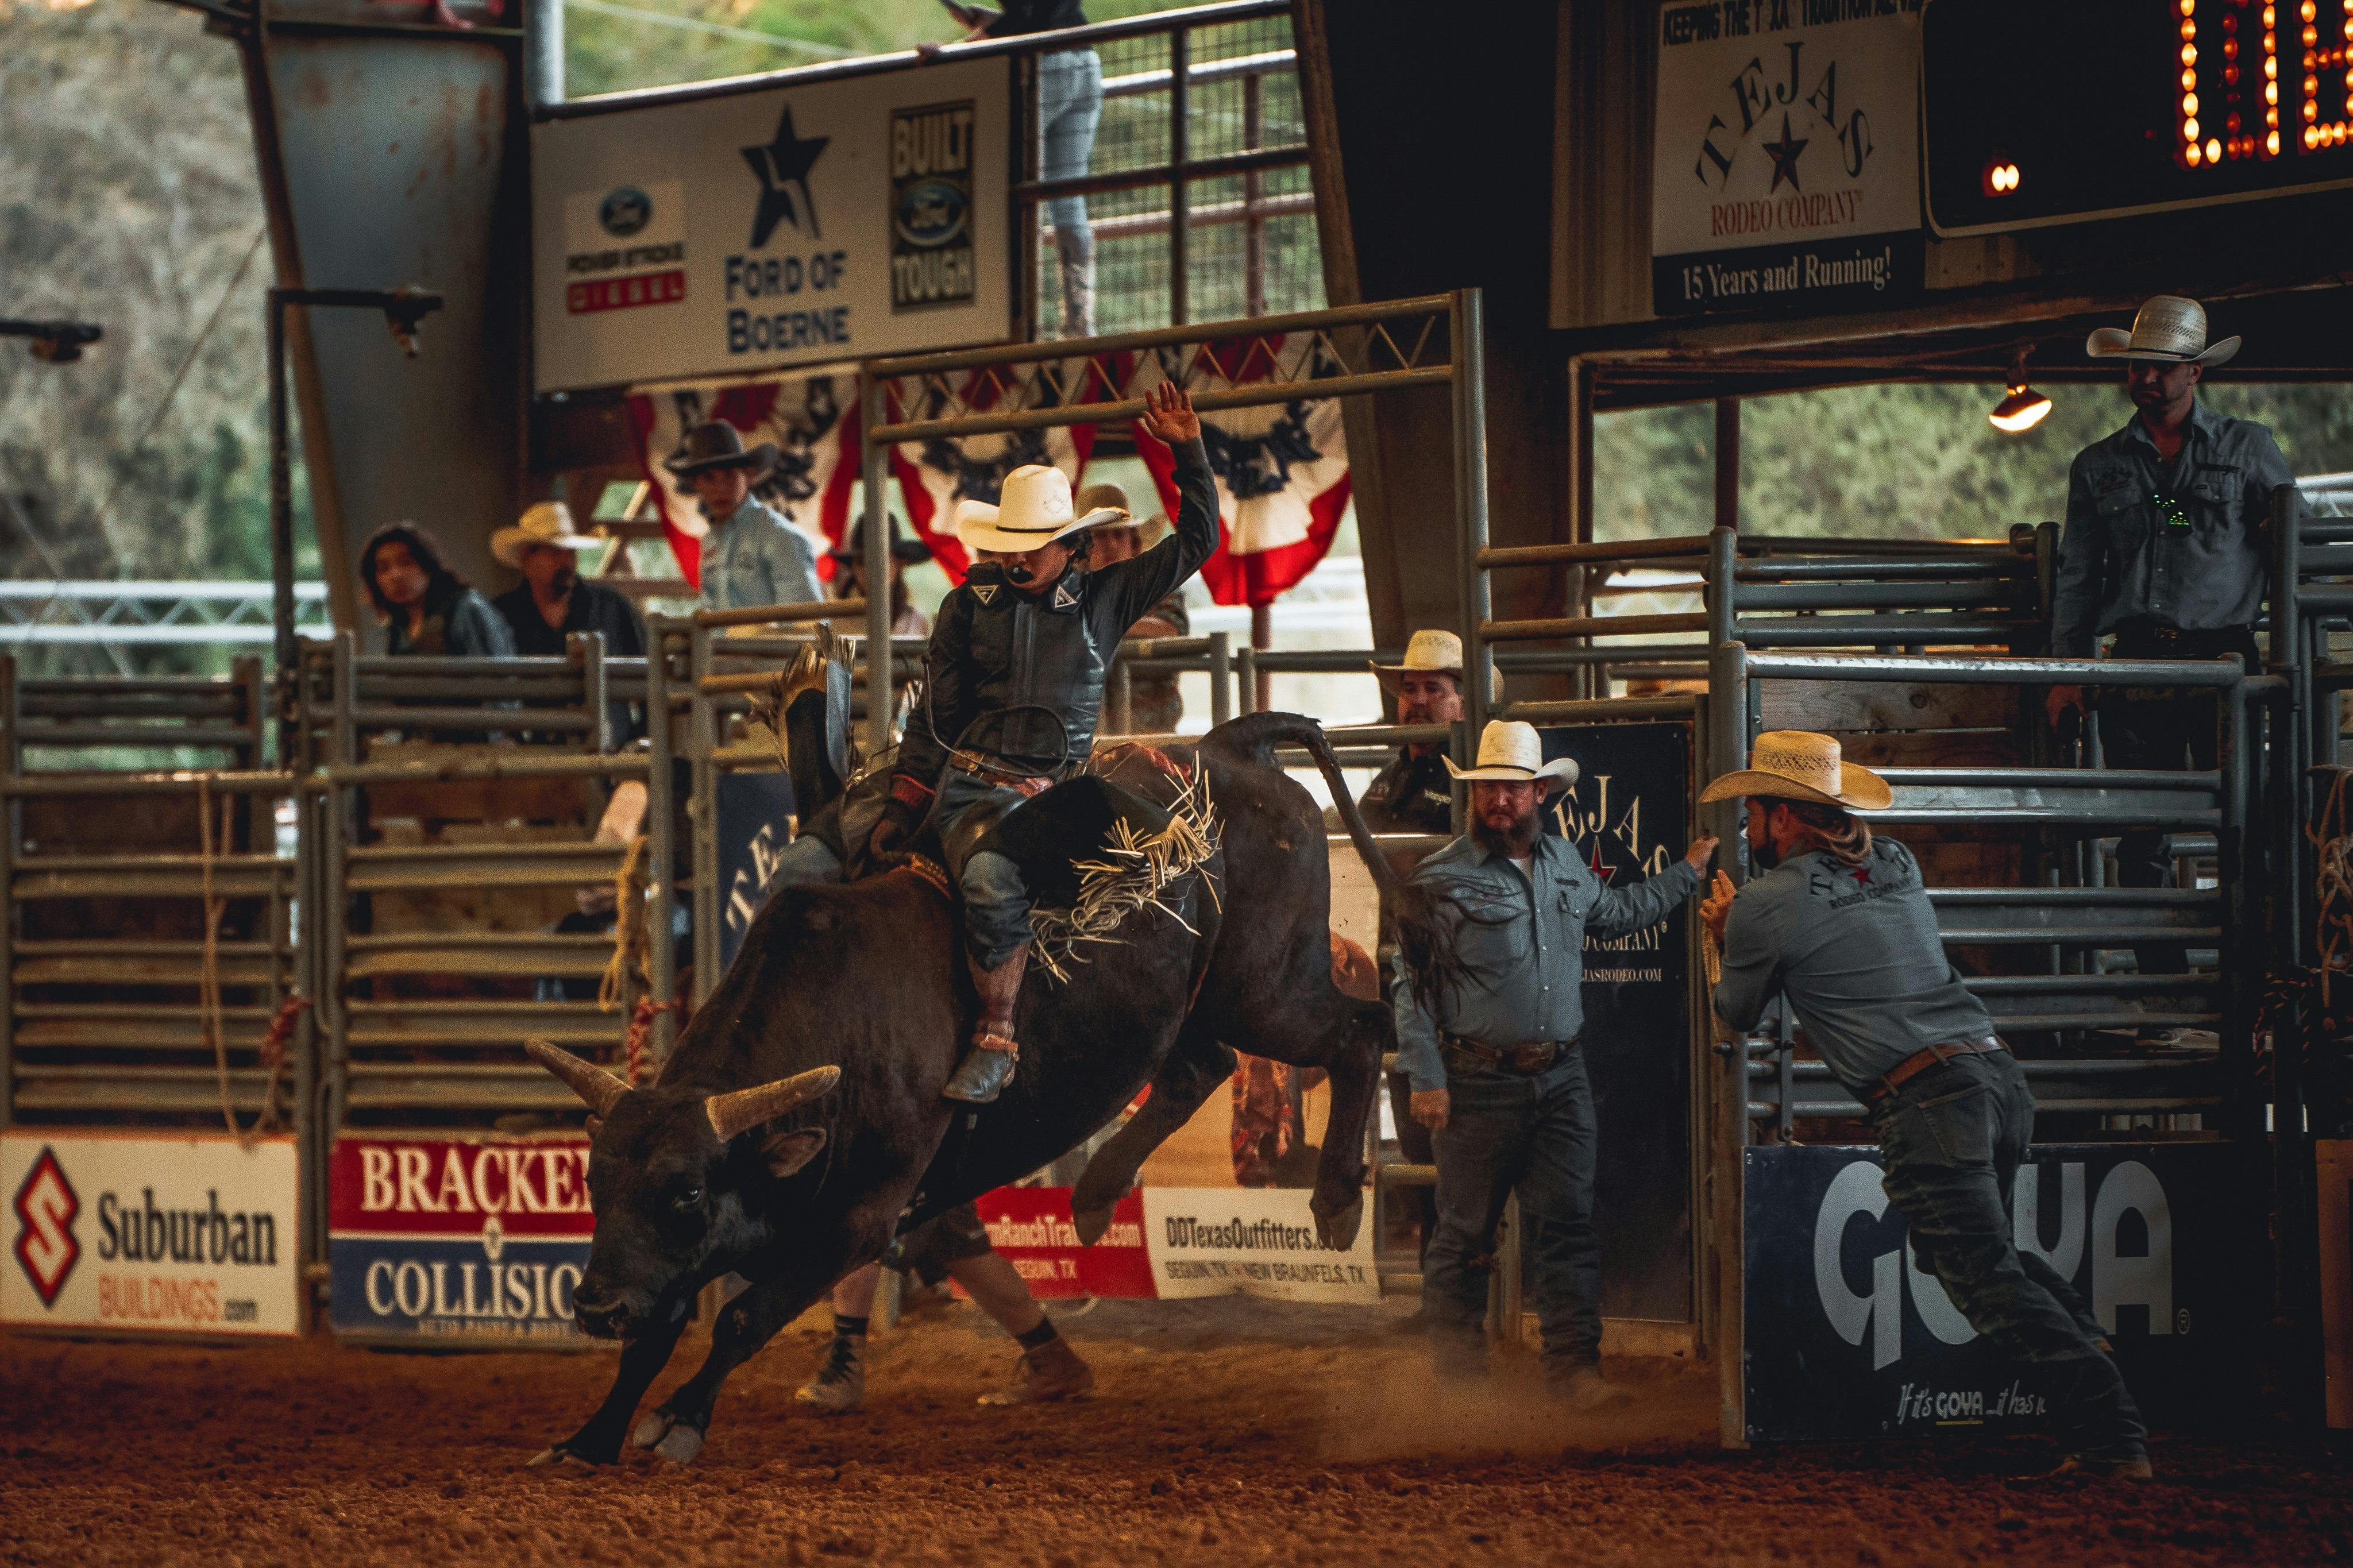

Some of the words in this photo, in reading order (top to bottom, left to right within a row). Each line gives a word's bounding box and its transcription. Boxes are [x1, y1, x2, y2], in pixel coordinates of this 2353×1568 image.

[1724, 0, 1750, 37] THE
[1695, 41, 1874, 191] TEJAS
[893, 109, 973, 179] BUILT
[1712, 200, 1773, 237] RODEO
[1777, 190, 1858, 231] COMPANY
[725, 254, 803, 302] FORD
[809, 249, 848, 291] OF
[893, 247, 973, 304] TOUGH
[1682, 265, 1704, 300] 15
[1706, 262, 1759, 299] Years
[1762, 254, 1799, 293] and
[1804, 245, 1892, 292] Running!
[728, 306, 850, 354] BOERNE
[97, 1187, 278, 1266] Suburban
[98, 1274, 219, 1321] BUILDINGS
[1243, 1262, 1272, 1281] NEW
[1348, 1264, 1366, 1284] TX
